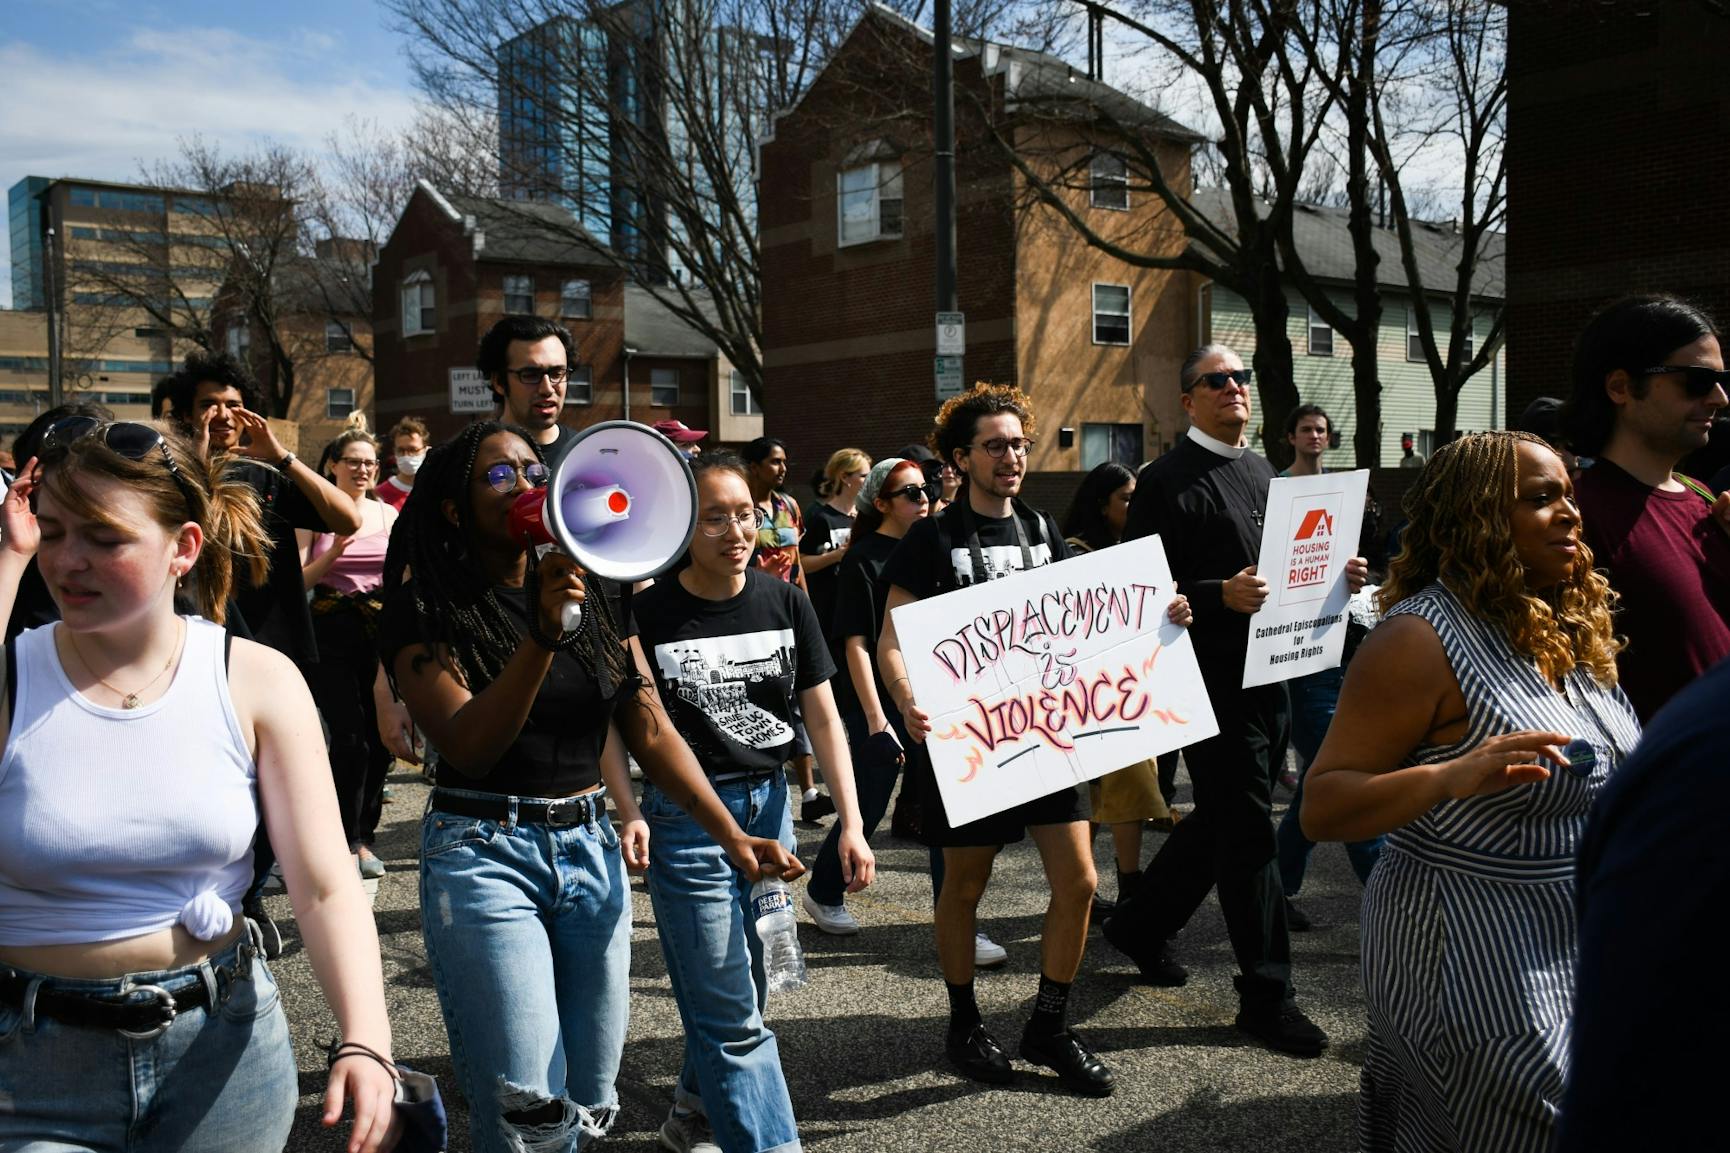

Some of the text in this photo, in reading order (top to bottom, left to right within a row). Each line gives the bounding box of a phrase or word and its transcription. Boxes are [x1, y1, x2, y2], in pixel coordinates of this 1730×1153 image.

[459, 386, 485, 395] MUST
[454, 400, 493, 408] TURN LEFT
[1293, 541, 1329, 556] HOUSING
[1291, 554, 1329, 566] IS A HUMAN
[1289, 564, 1327, 584] RIGHT
[933, 582, 1158, 684] DISPLACEMENT
[1256, 614, 1343, 639] Cathedral Episcopalians
[1293, 635, 1304, 646] for
[1269, 645, 1323, 665] Housing Rights
[1041, 642, 1077, 690] is
[965, 665, 1150, 751] VIOLENCE
[719, 713, 744, 727] SAVE
[727, 710, 763, 732] THE UC
[734, 718, 772, 737] TOWN
[745, 723, 786, 746] HOMES
[758, 894, 780, 907] DEER
[760, 900, 782, 913] PARK
